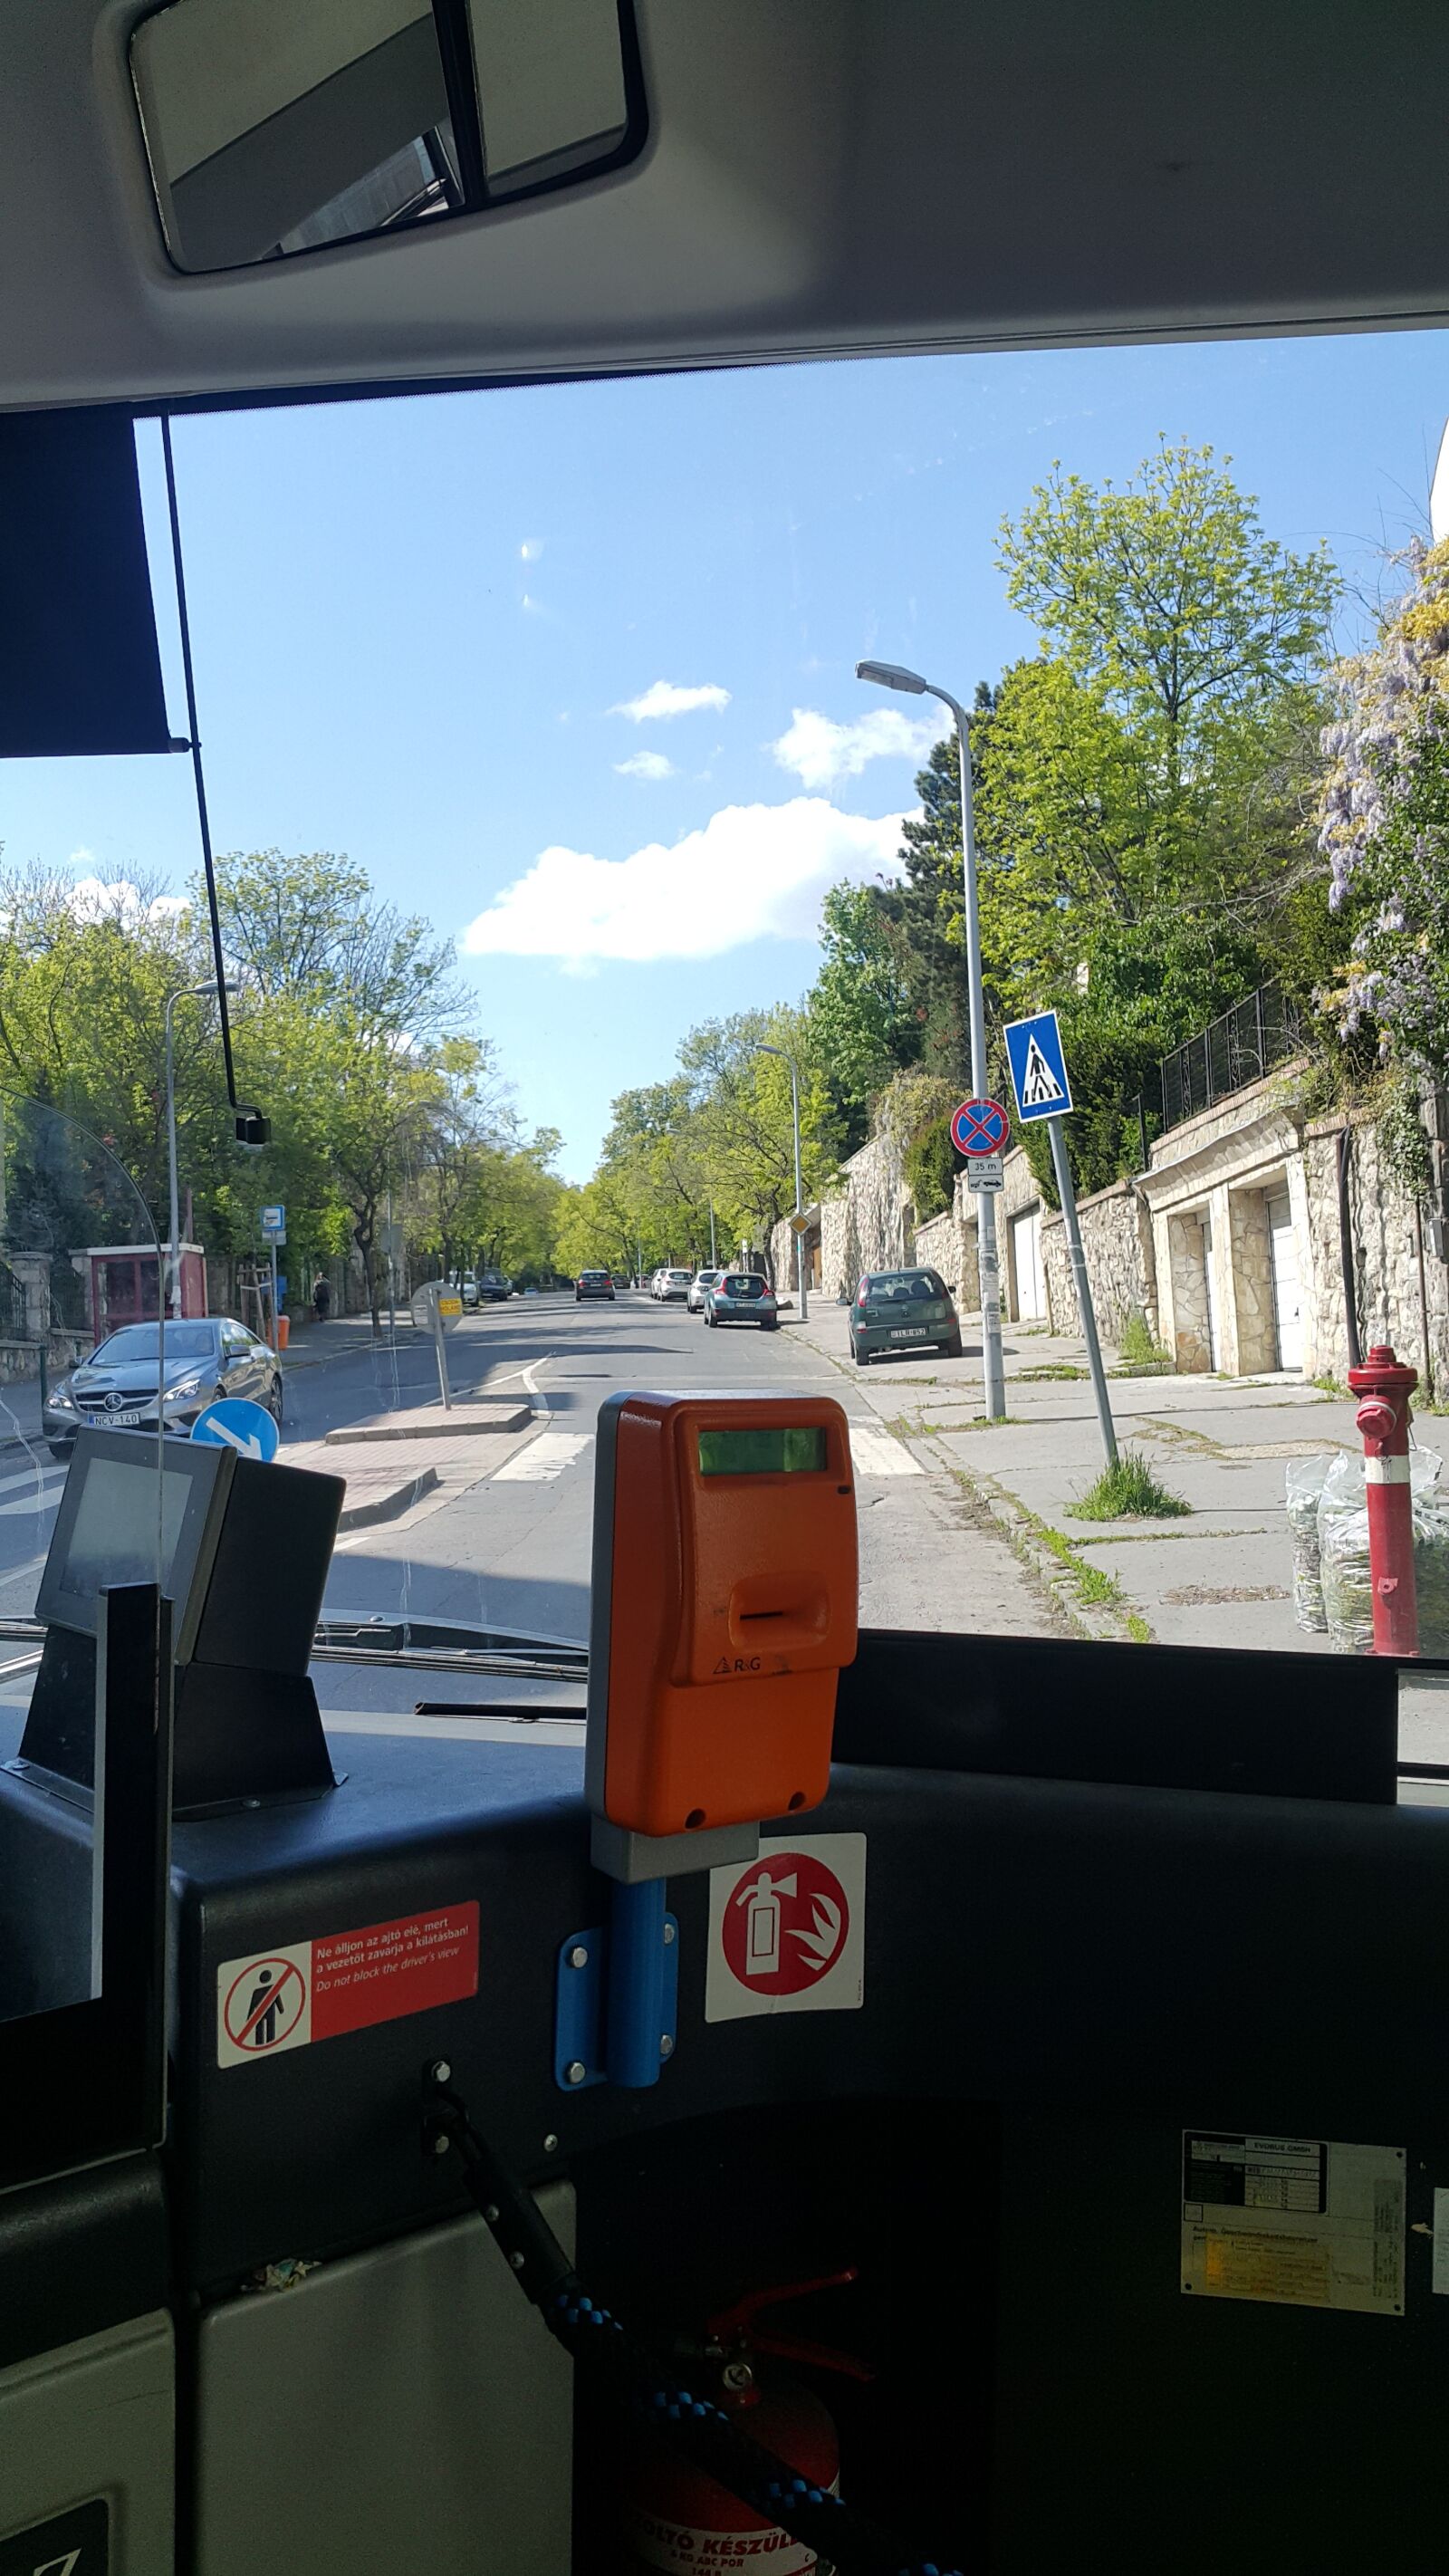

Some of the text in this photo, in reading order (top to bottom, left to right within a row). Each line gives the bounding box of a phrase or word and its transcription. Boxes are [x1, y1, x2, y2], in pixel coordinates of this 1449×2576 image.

[974, 1162, 985, 1171] 35
[95, 1414, 138, 1426] NCV-140
[316, 1925, 469, 1974] a vezetőt zavarja a kilátásban!
[317, 1918, 449, 1960] Ne álljon az ajtó elé, mert
[316, 1946, 460, 1993] Do not block the driver's view
[702, 2532, 798, 2556] KÉSZÜL
[697, 2556, 718, 2567] ABC
[721, 2558, 744, 2568] POR
